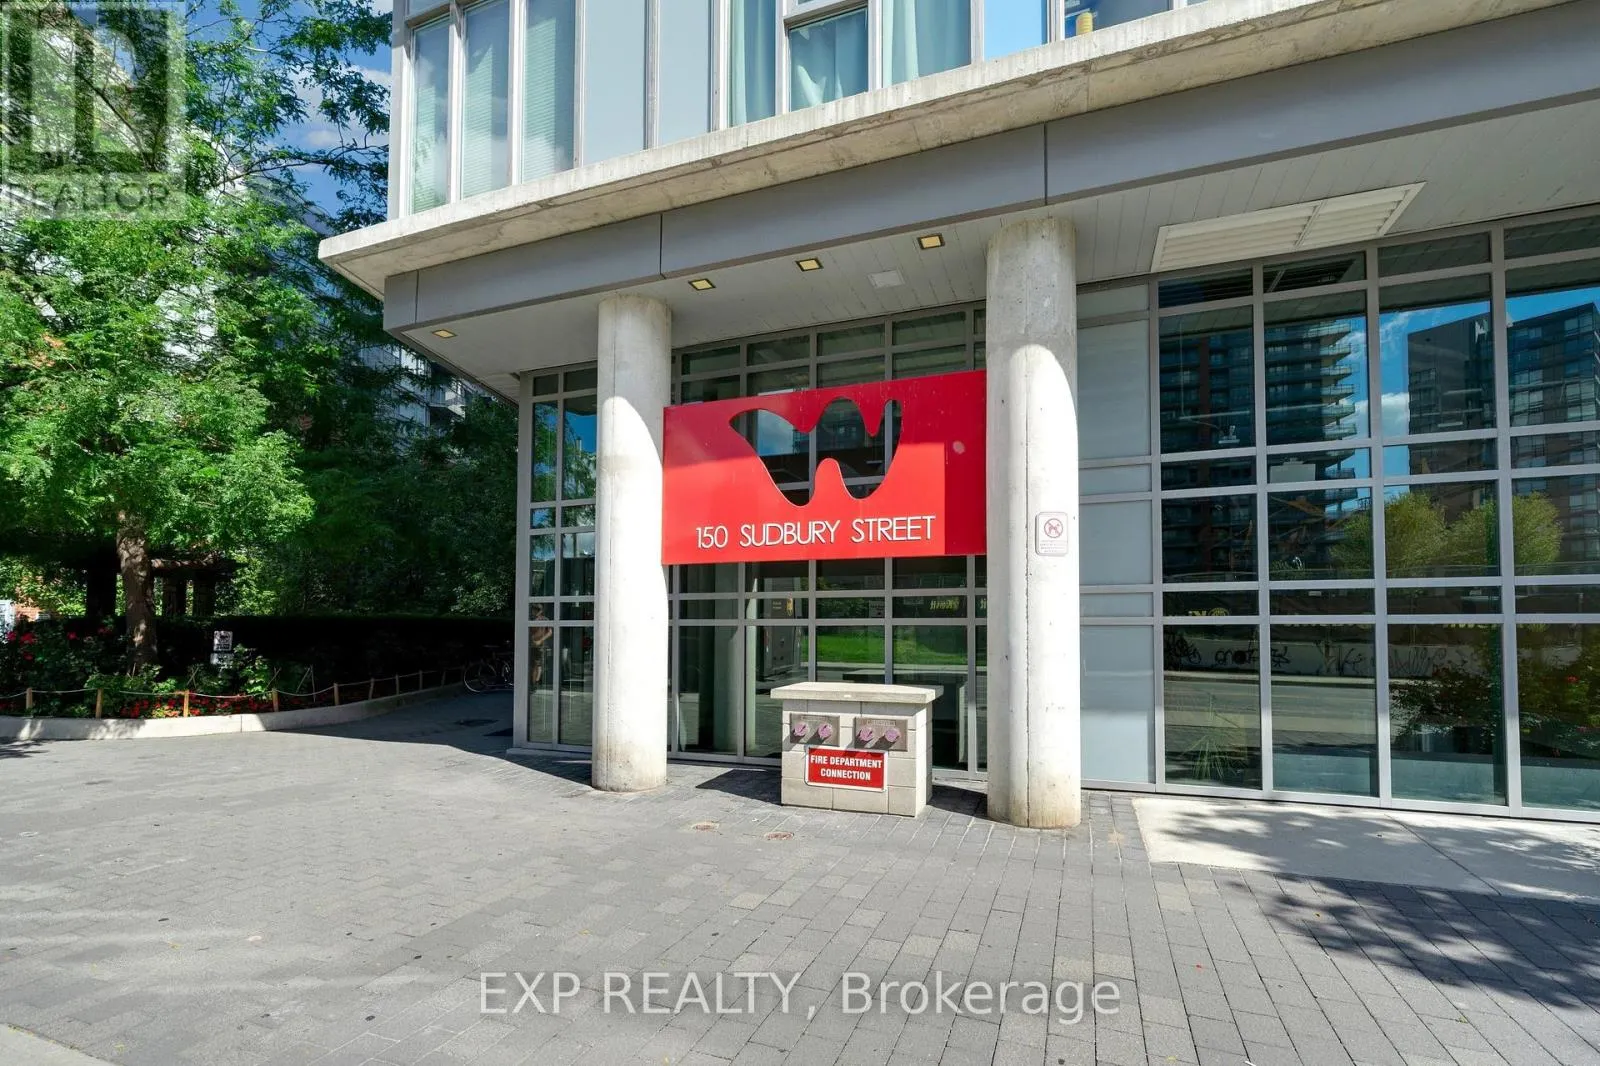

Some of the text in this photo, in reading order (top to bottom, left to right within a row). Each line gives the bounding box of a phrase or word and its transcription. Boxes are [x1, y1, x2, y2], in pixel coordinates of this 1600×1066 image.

[696, 515, 936, 549] 150 SUDBURY STREET
[810, 755, 883, 769] FIRE DEPARTMENT
[820, 768, 871, 780] CONNECTION
